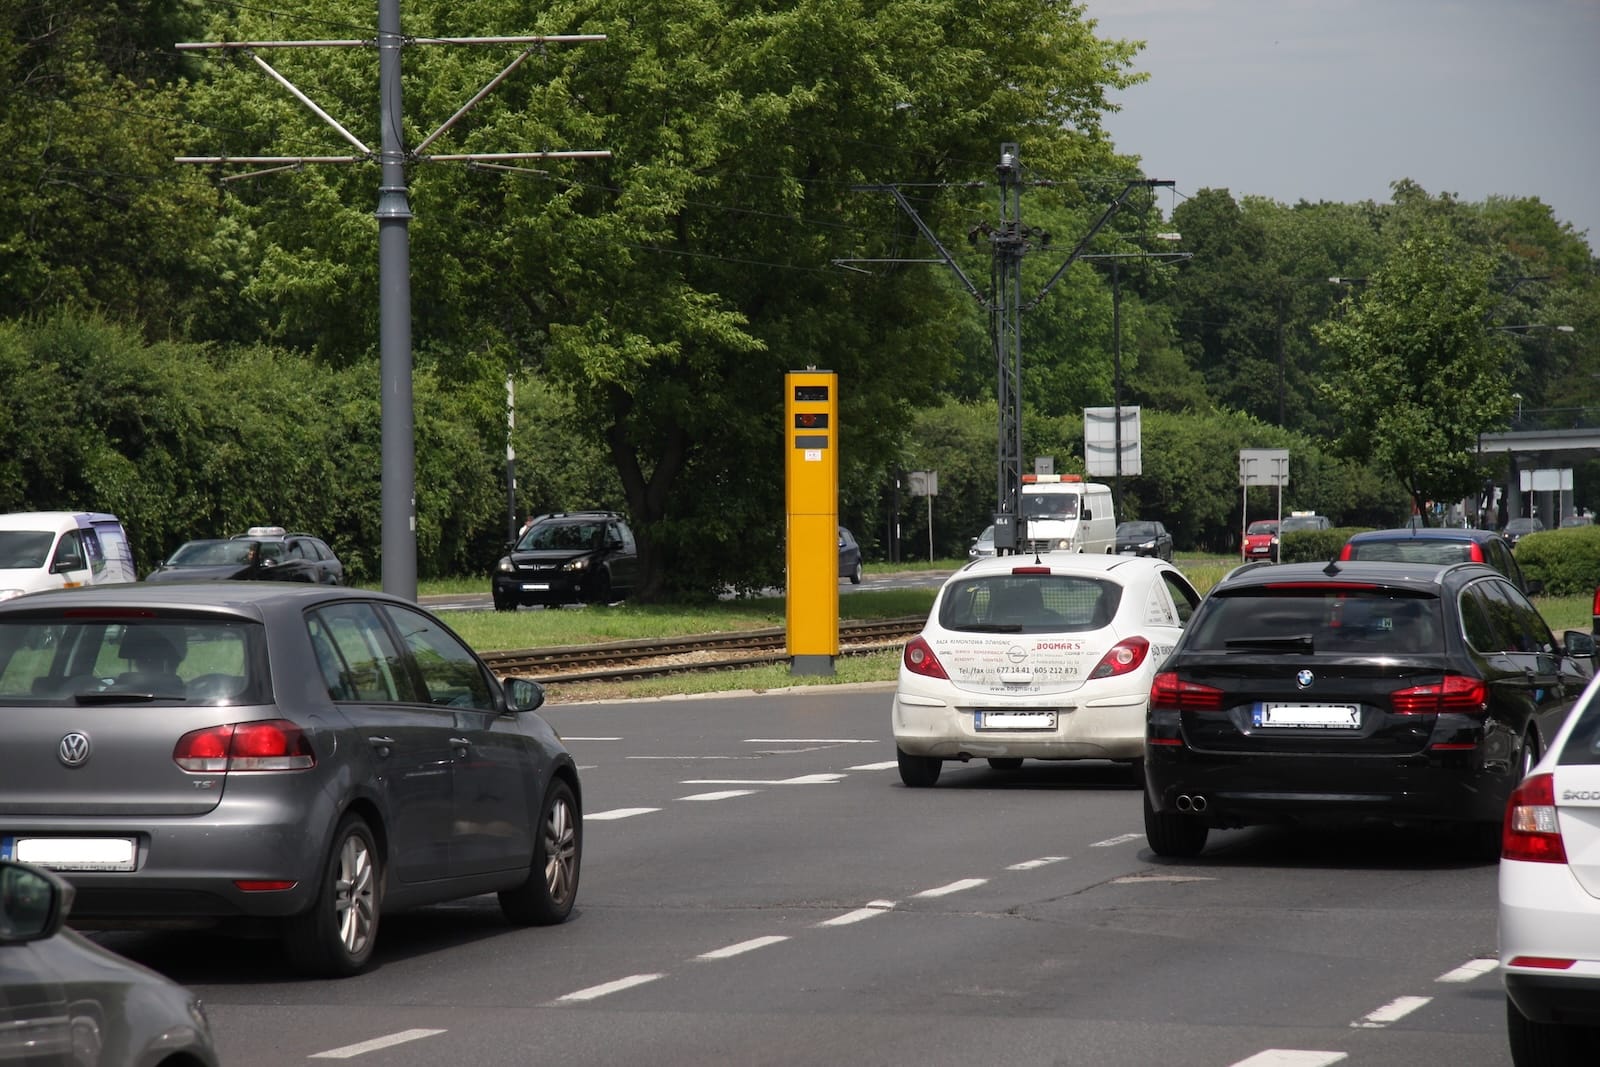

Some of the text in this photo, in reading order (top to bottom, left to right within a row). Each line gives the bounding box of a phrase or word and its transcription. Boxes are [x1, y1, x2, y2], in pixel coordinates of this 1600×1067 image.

[996, 666, 1009, 674] 677
[1049, 666, 1063, 674] 212
[1064, 667, 1078, 675] 873
